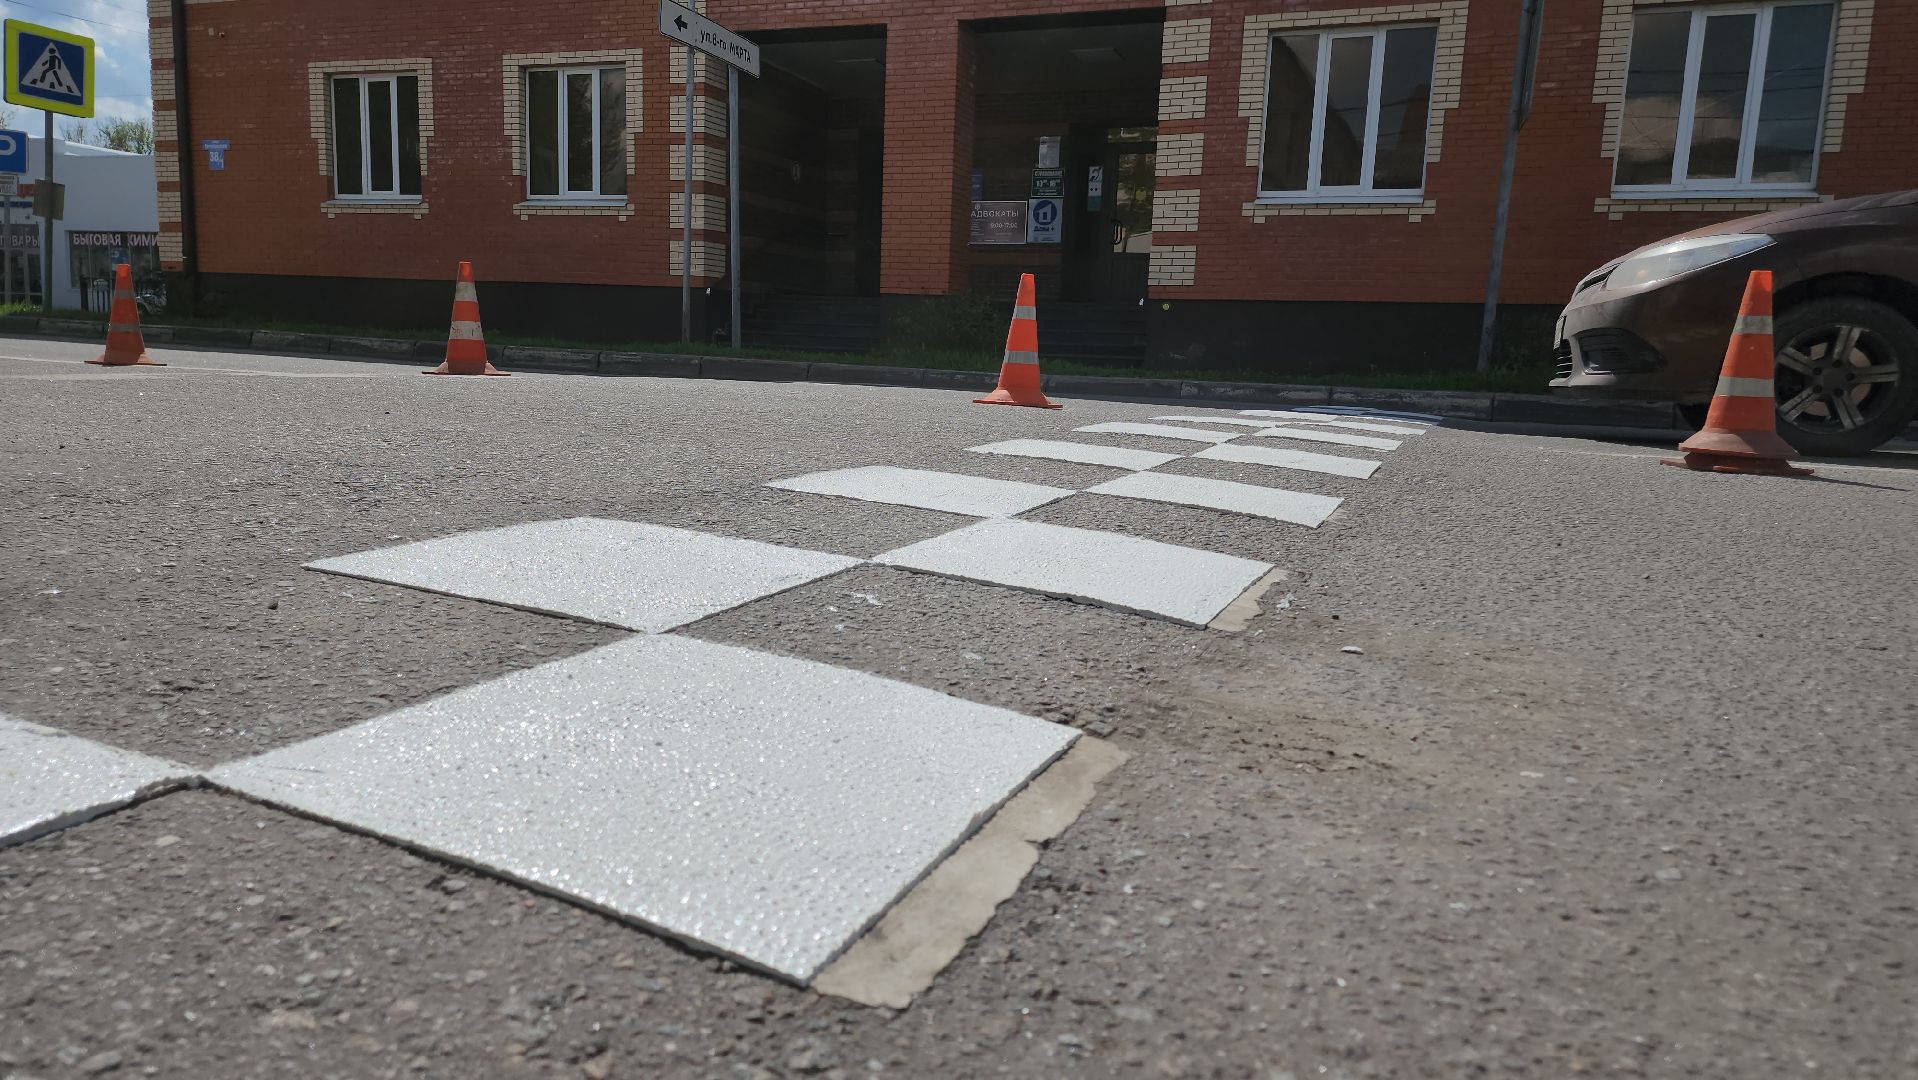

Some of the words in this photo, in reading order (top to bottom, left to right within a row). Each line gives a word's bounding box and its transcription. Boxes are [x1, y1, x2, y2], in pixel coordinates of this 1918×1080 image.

[970, 210, 1019, 218] АДВОКАТЫ
[0, 235, 40, 247] ТВАРЫ
[73, 233, 122, 246] БЫТОВАЯ
